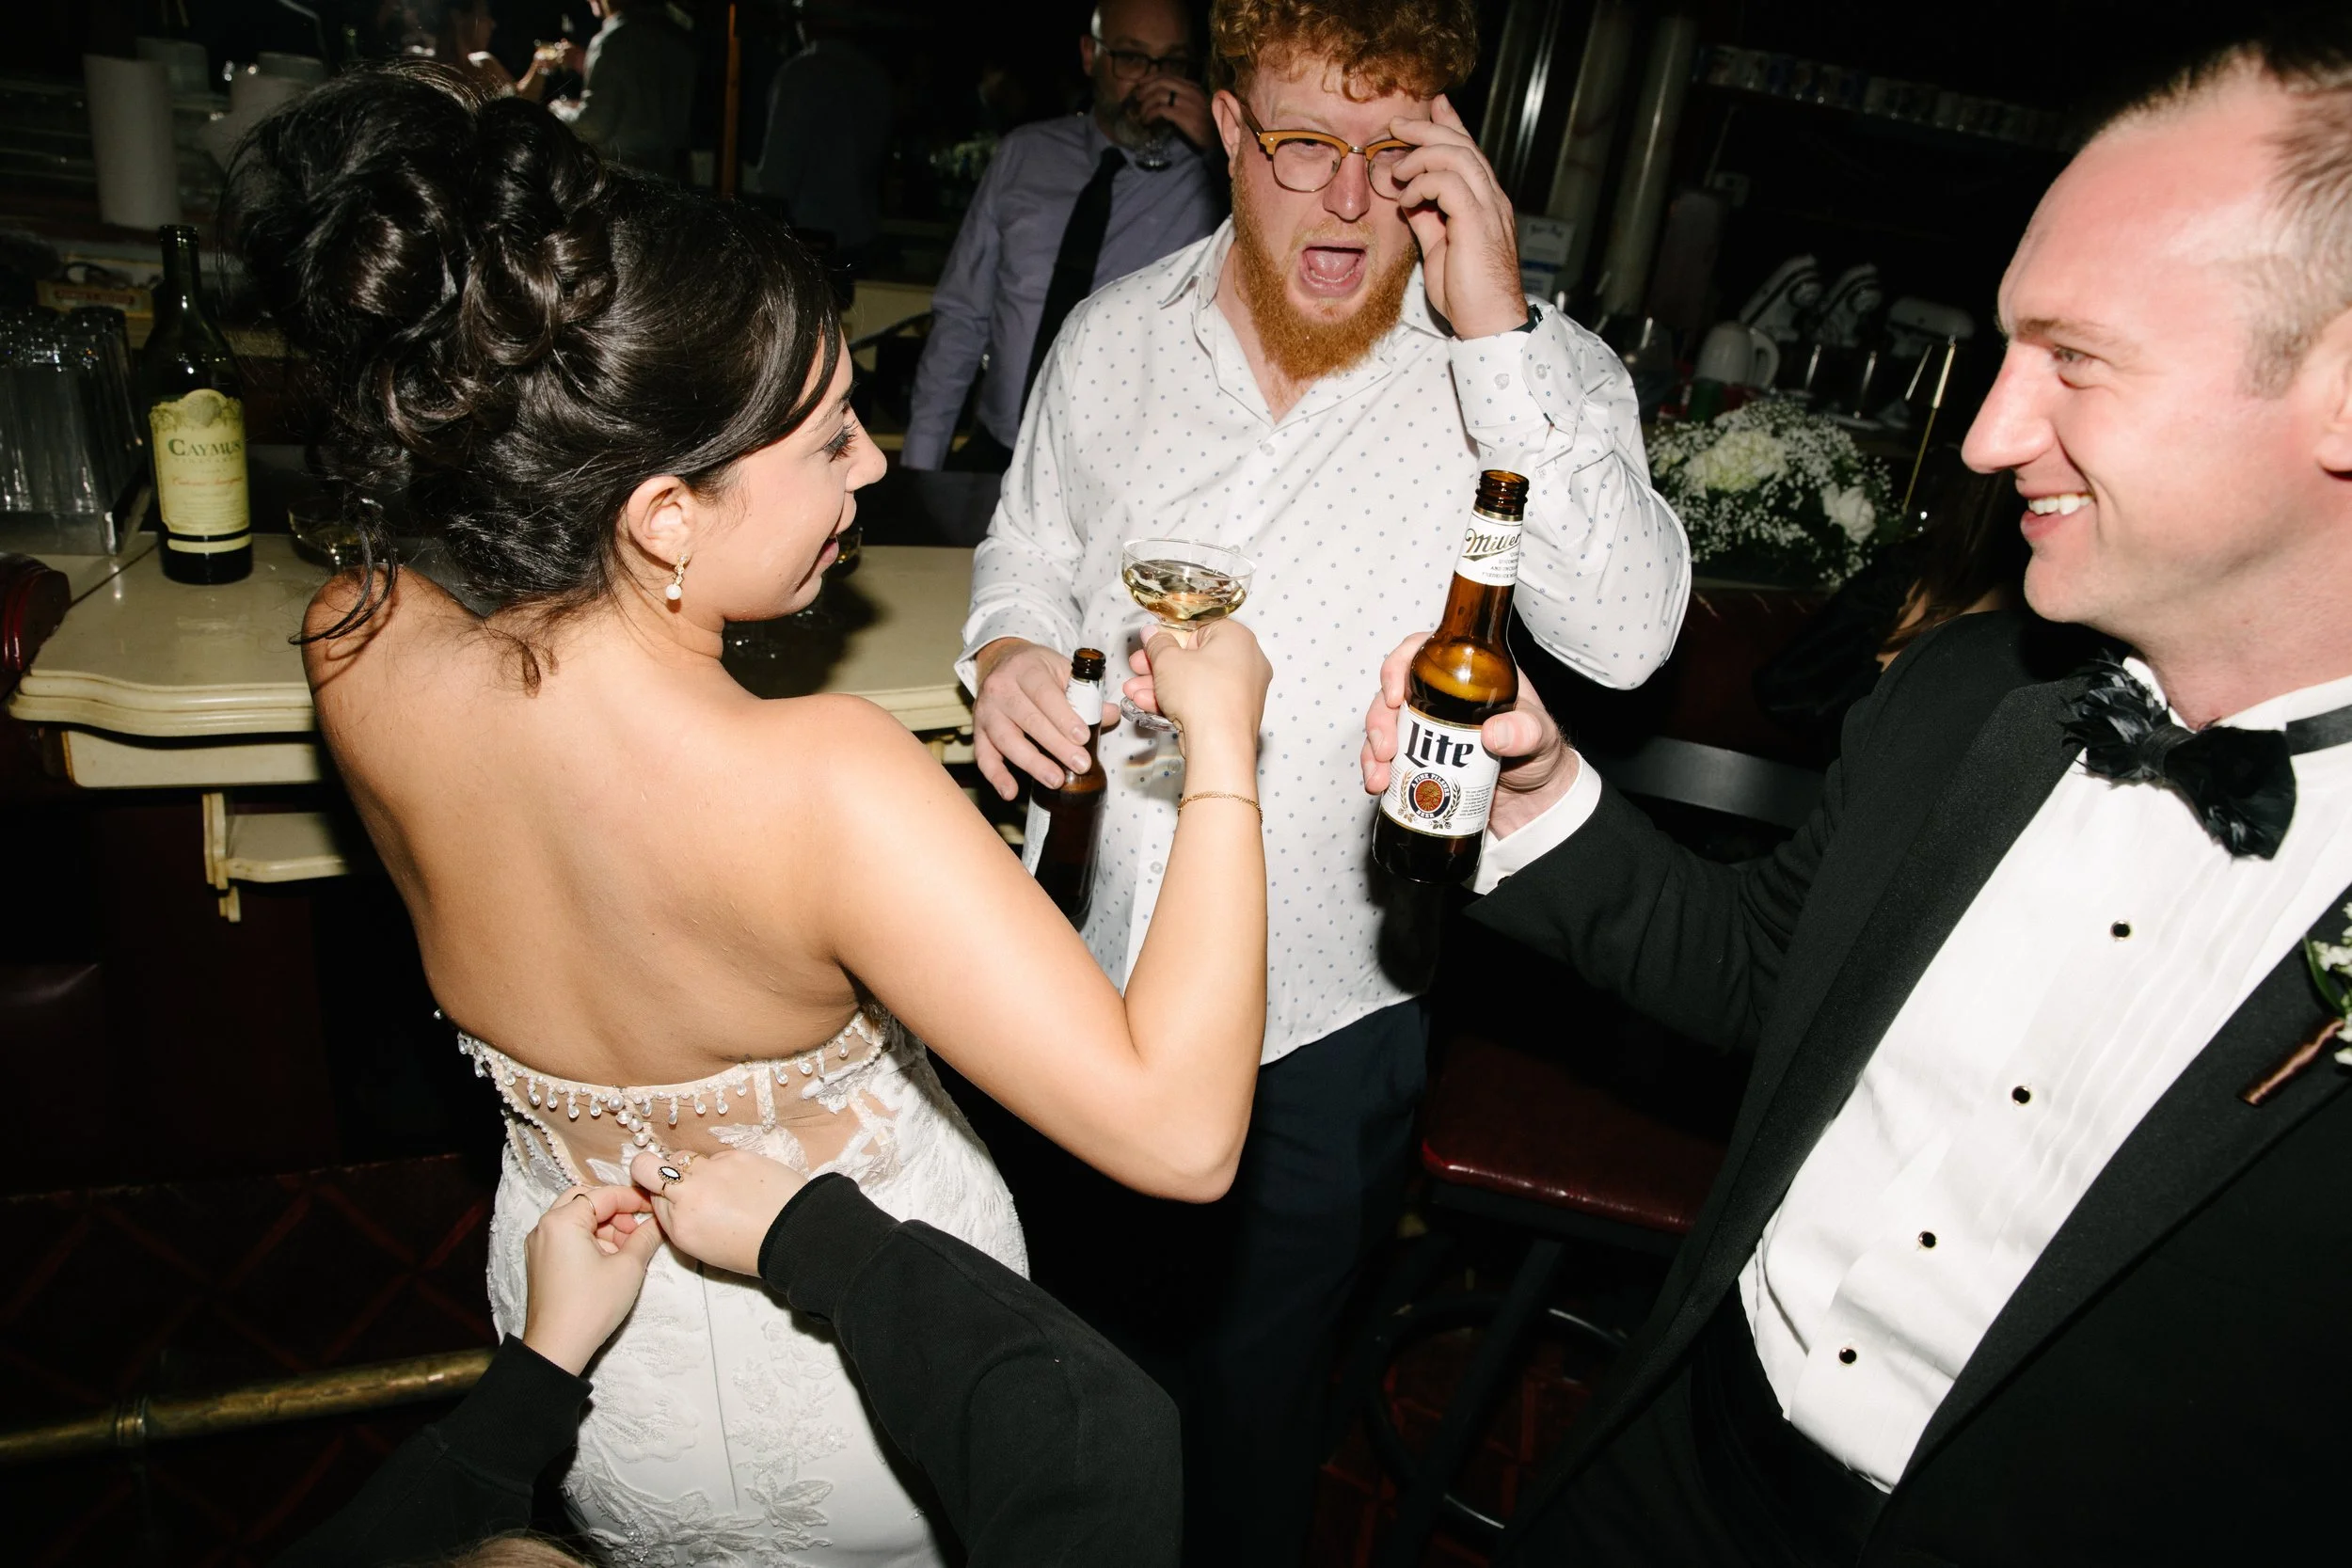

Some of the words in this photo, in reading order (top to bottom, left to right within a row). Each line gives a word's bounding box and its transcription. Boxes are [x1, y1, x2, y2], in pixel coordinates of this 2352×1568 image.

[167, 438, 242, 457] CAYMUS
[1465, 528, 1521, 554] Miller
[1404, 720, 1474, 768] Lite
[1414, 773, 1429, 783] FINE
[1431, 773, 1450, 798] PILSNER
[1416, 809, 1435, 818] BEER
